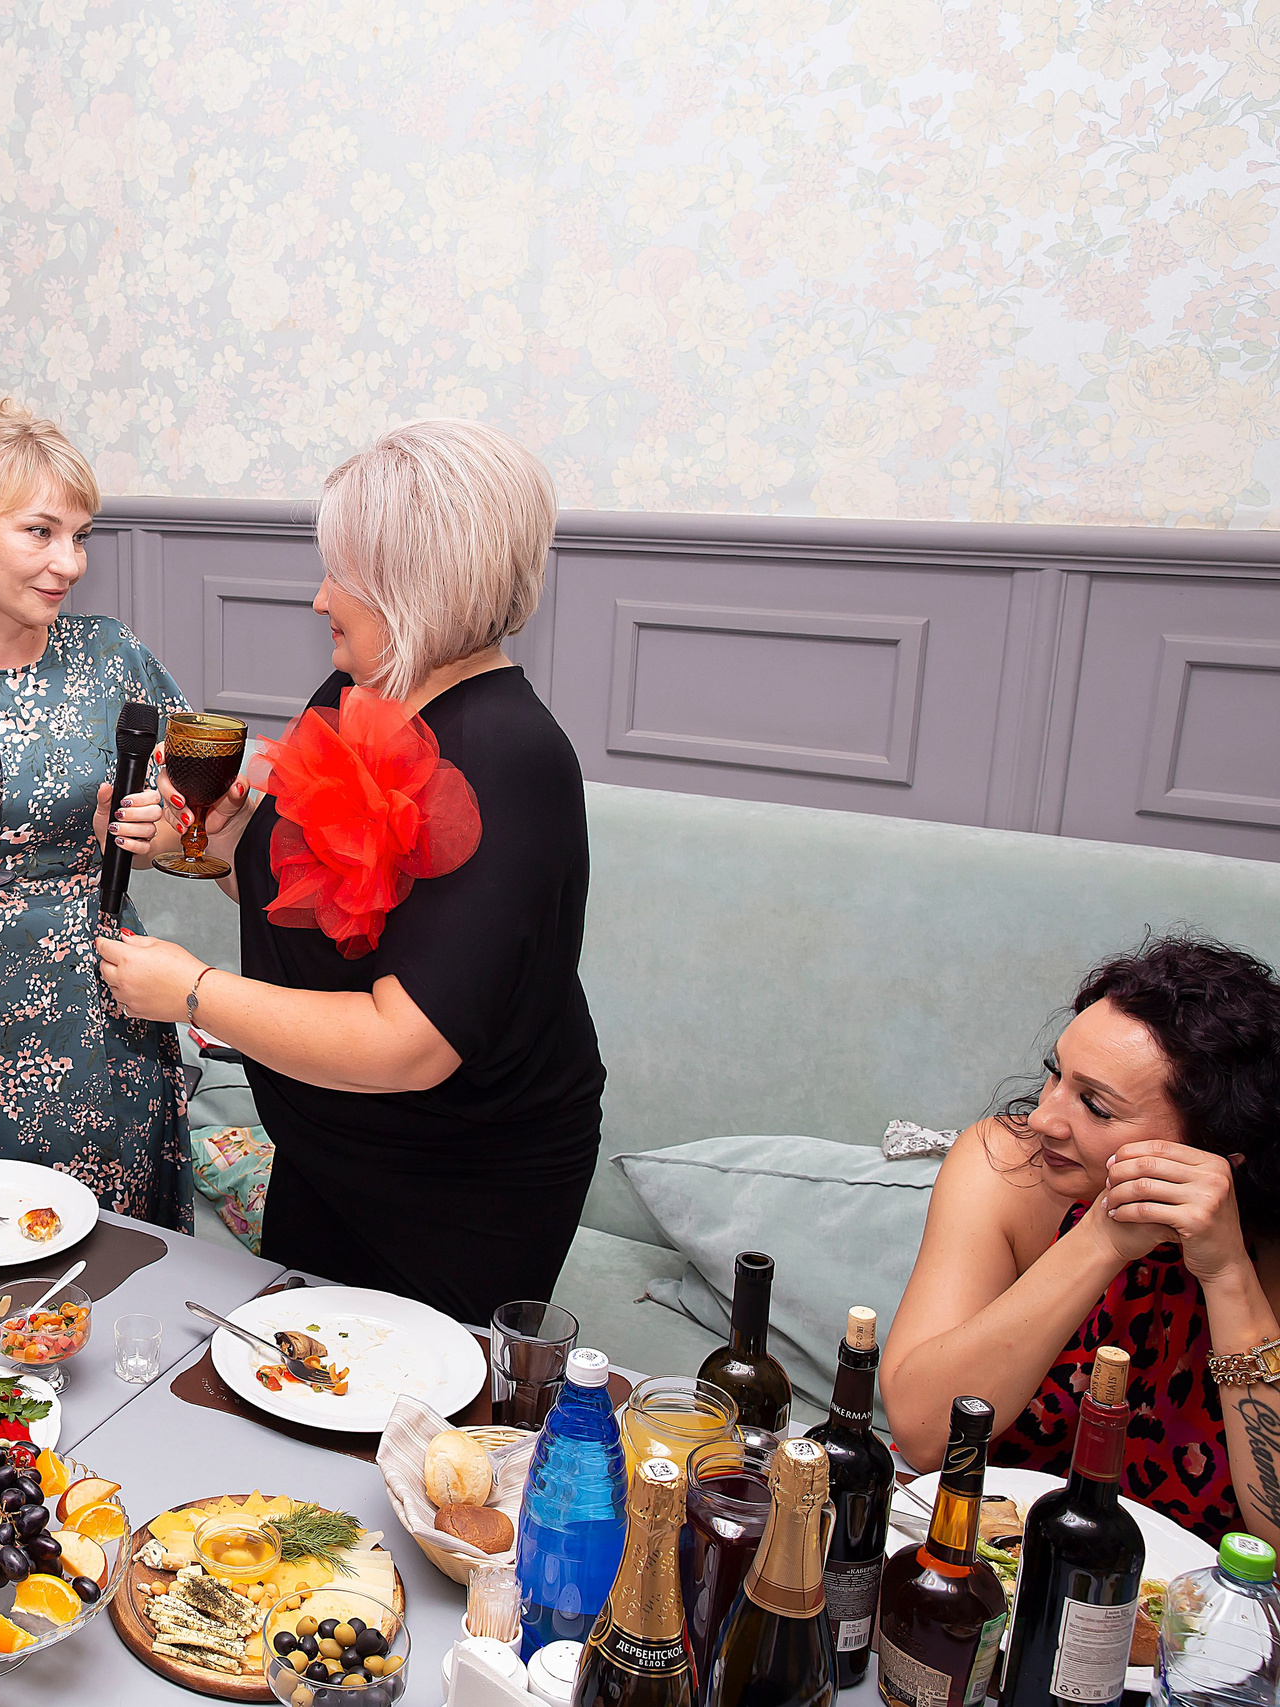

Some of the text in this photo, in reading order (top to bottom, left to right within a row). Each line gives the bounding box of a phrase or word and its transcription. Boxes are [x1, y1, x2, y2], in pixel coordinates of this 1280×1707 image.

[1106, 1375, 1117, 1402] CHAIS
[830, 1401, 873, 1420] INKERMAN
[616, 1639, 684, 1660] ДЕРБЕНТСКОЕ
[638, 1659, 666, 1667] БЕЛОЕ
